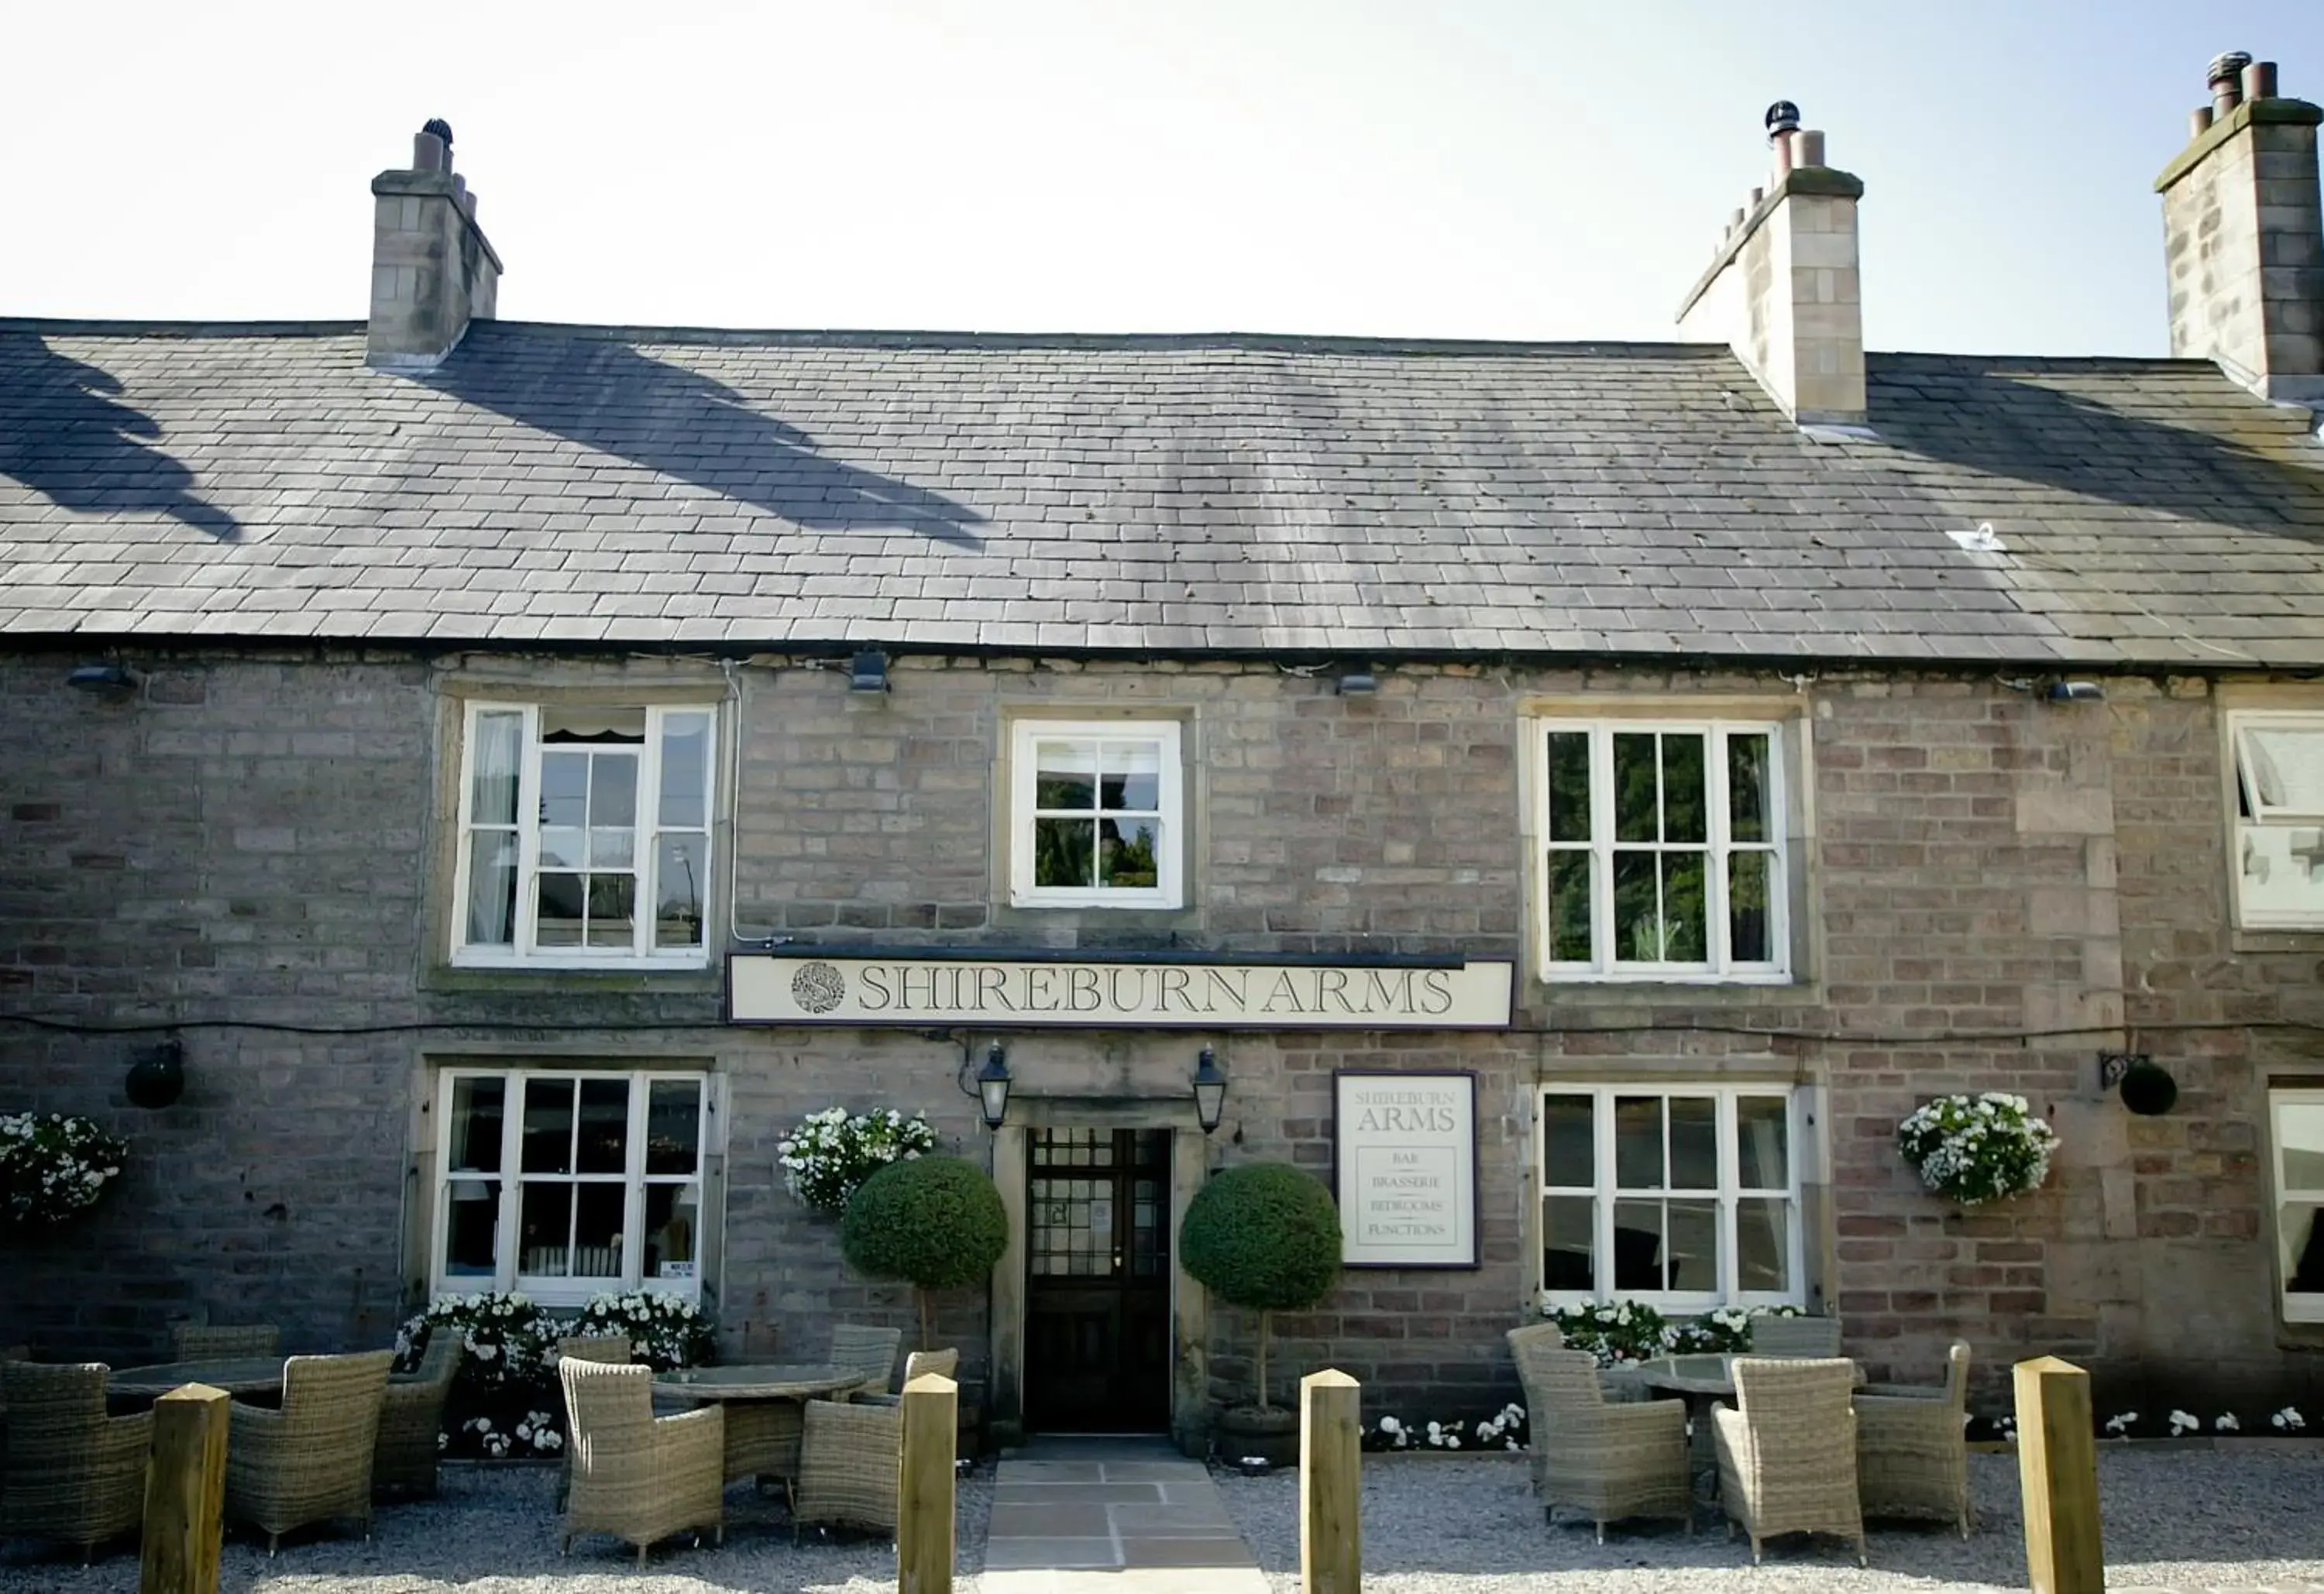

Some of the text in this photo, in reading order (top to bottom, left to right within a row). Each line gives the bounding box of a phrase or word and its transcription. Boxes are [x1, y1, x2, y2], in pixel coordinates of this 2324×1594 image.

[859, 966, 1452, 1014] SHIREBURN ARMS
[1358, 1107, 1456, 1133] ARMS
[1373, 1177, 1440, 1189] BRASSERIE
[1367, 1223, 1446, 1237] FUNCTIONS
